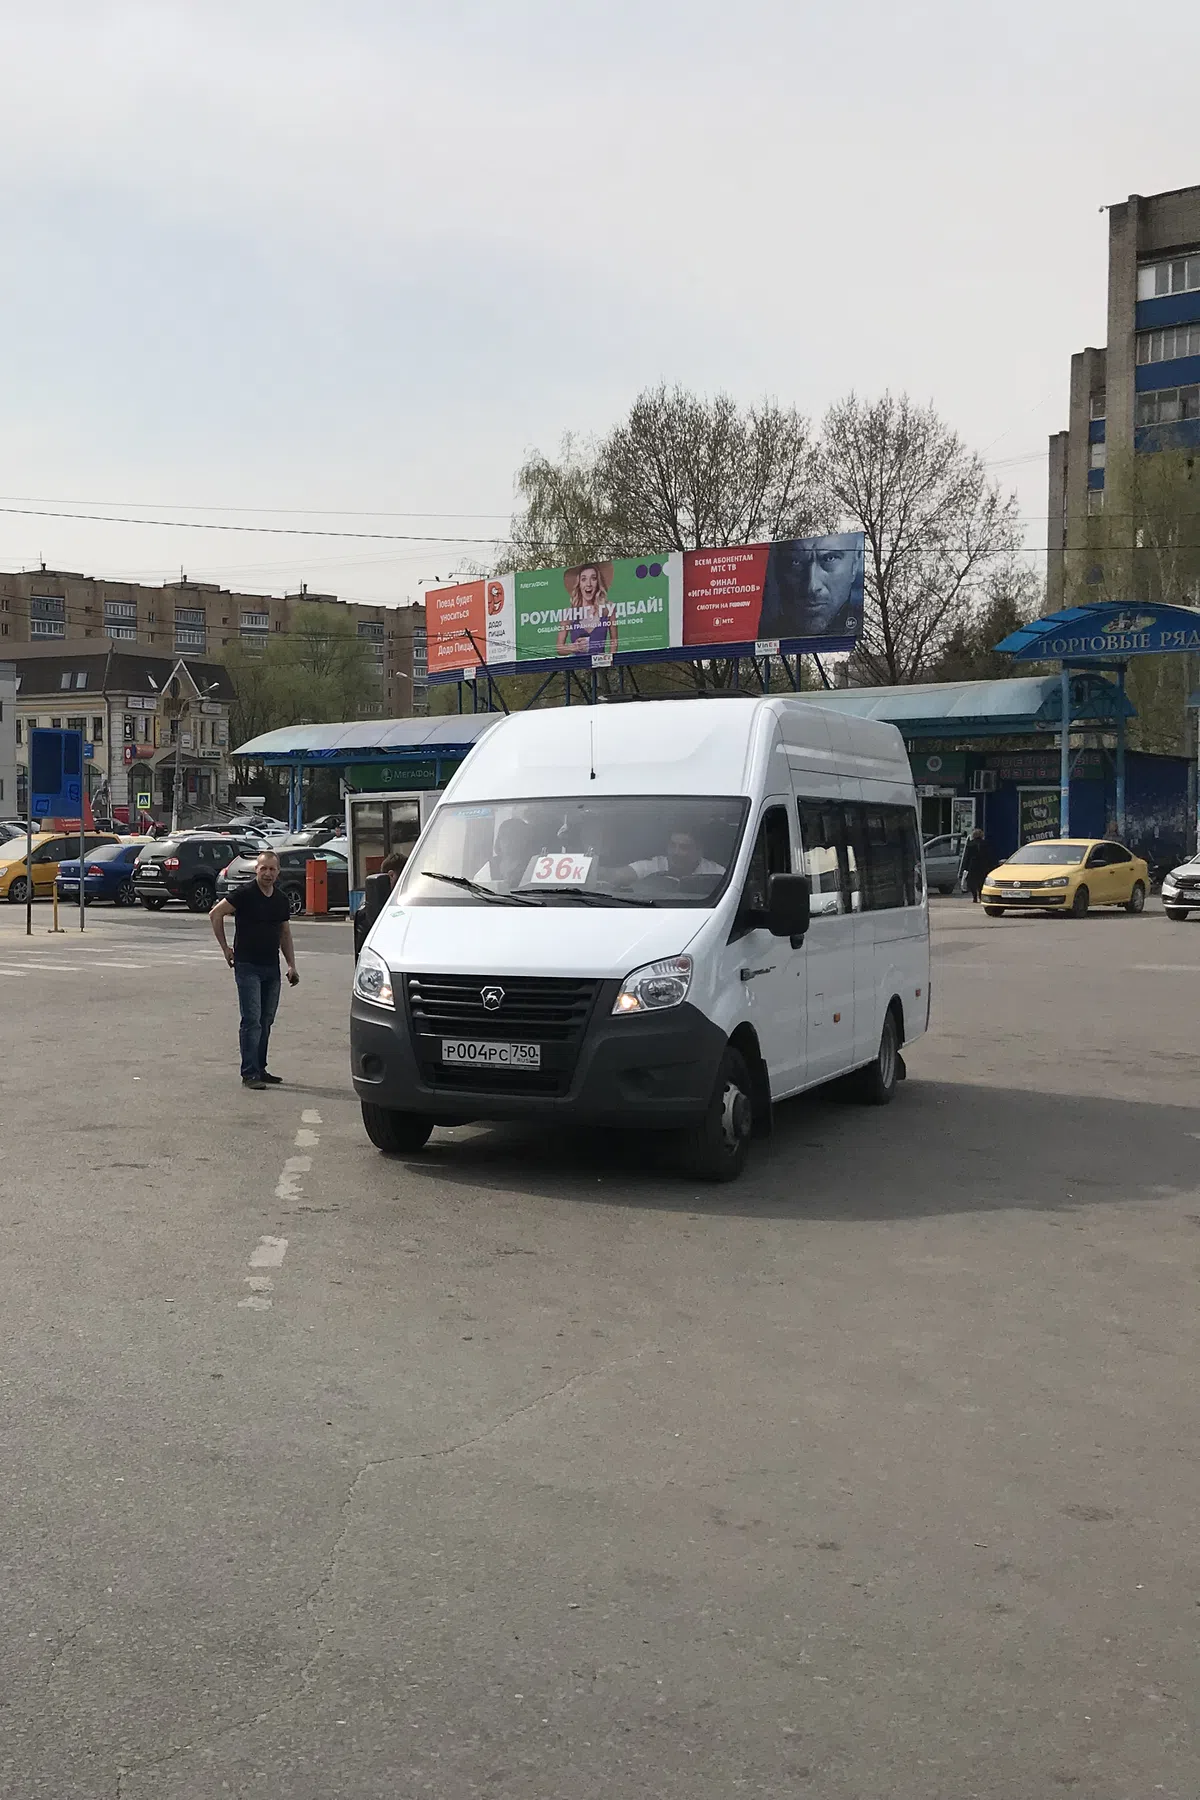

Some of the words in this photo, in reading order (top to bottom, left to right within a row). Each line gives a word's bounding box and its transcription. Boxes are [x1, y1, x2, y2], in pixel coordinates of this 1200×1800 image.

[694, 557, 712, 567] ВСЕМ
[713, 553, 754, 565] АБОНЕНТАМ
[710, 565, 727, 573] МТС
[728, 564, 737, 572] ТВ
[710, 577, 737, 587] ФИНАЛ
[687, 588, 712, 598] «ИГРЫ
[713, 584, 761, 596] ПРЕСТОЛОВ»
[436, 598, 455, 609] Поезд
[456, 594, 473, 607] будет
[696, 602, 720, 611] СМОТРИ
[440, 609, 470, 625] уноситься
[520, 605, 594, 627] РОУМИНГ,
[598, 596, 664, 618] ГУДБАЙ!
[565, 623, 573, 631] ЗА
[602, 620, 612, 628] ПО
[612, 619, 627, 627] ЦЕНЕ
[627, 617, 644, 625] КОФЕ
[722, 617, 734, 625] МТС
[1038, 633, 1150, 654] ТОРГОВЫЕ
[437, 645, 454, 657] Додо
[1022, 794, 1058, 809] ПОКУПКА
[511, 1045, 536, 1058] 750
